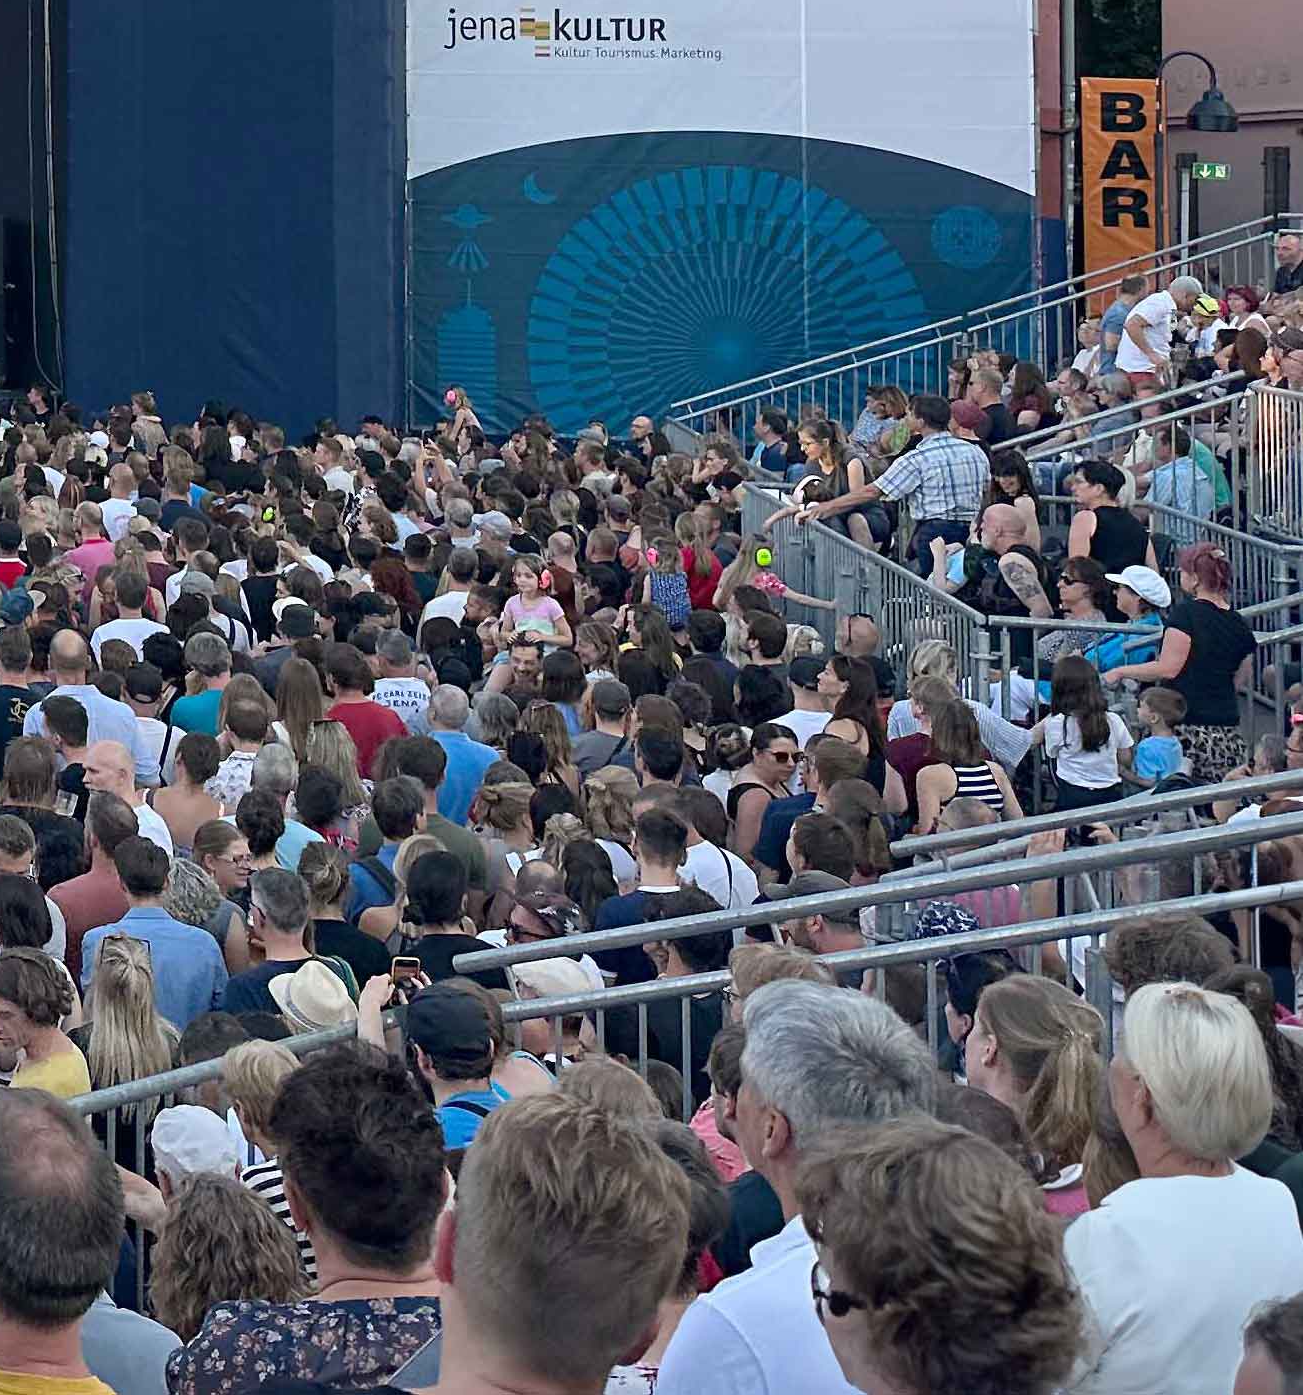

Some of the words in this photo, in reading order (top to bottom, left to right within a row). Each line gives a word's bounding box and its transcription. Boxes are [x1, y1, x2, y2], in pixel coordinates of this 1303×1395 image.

[443, 8, 517, 50] jena
[660, 47, 722, 61] Marketing
[1099, 91, 1151, 228] BAR
